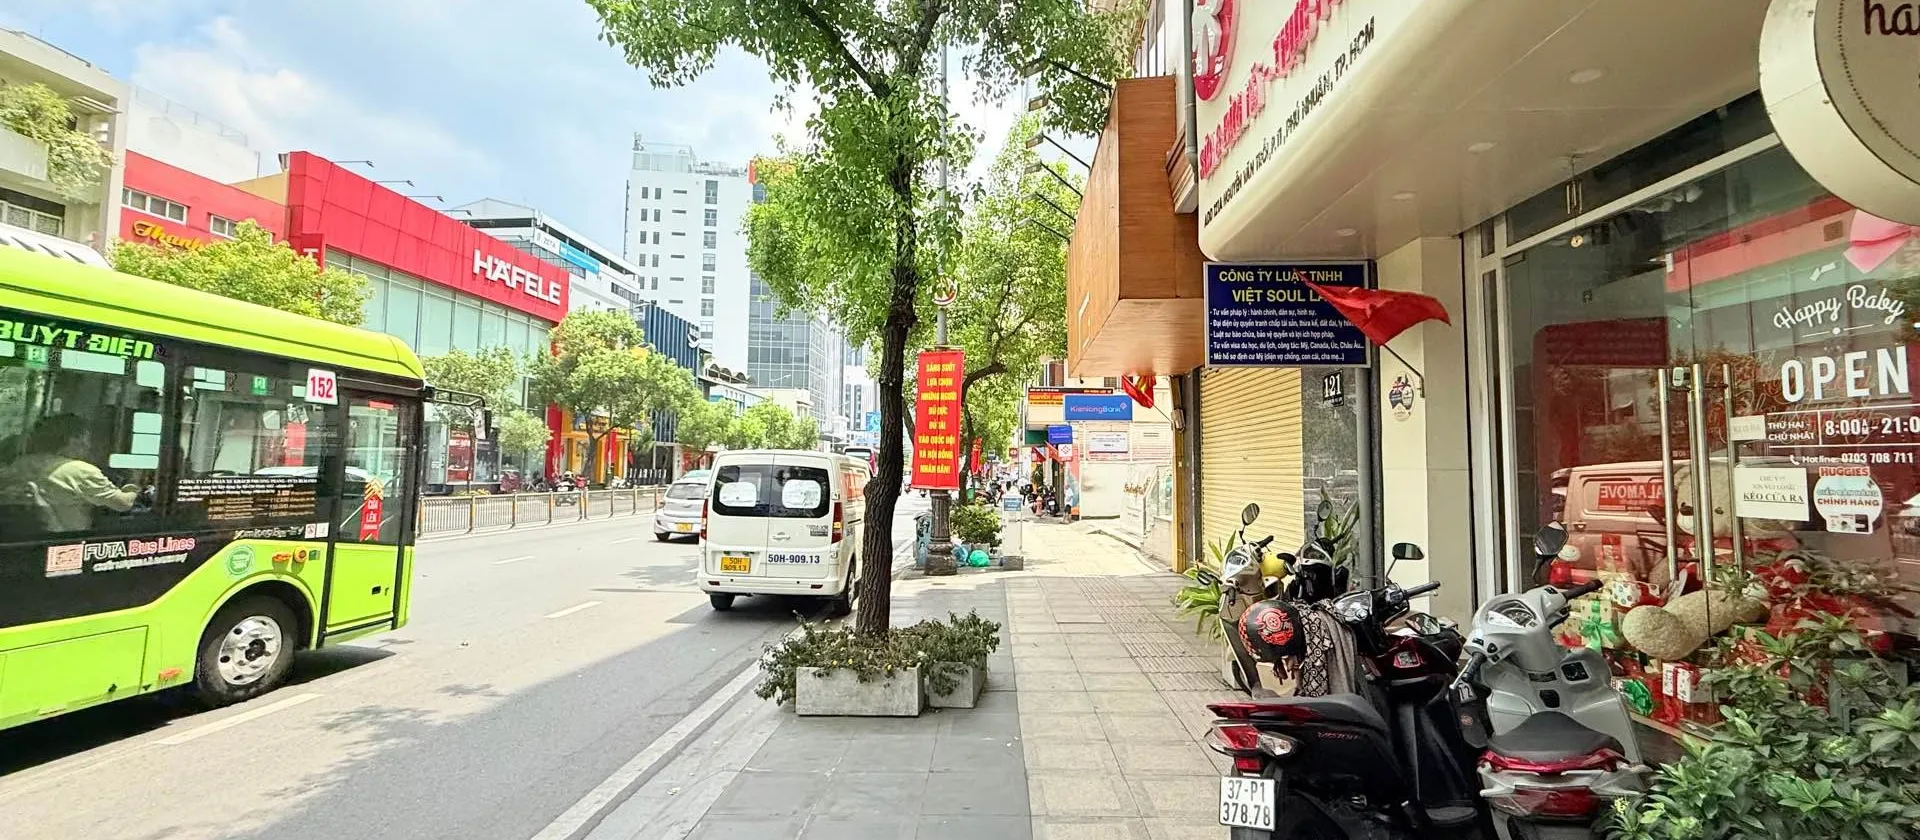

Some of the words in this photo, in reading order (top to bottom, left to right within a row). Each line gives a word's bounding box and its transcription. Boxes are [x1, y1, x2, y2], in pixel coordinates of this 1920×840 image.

[1864, 0, 1920, 35] ha
[1350, 16, 1375, 65] HCM
[473, 249, 561, 306] HÄFELE
[1219, 268, 1255, 282] CÔNG
[1257, 270, 1273, 282] TY
[1309, 270, 1343, 282] TNHH
[1232, 286, 1263, 306] VIỆT
[1266, 289, 1306, 303] SOUL
[1773, 296, 1842, 329] Happy
[1846, 284, 1905, 325] Baby
[1781, 345, 1910, 403] OPEN
[310, 376, 333, 399] 152
[1324, 374, 1342, 398] 121
[1767, 419, 1787, 431] THỨ
[1789, 422, 1805, 430] HAI
[1768, 430, 1788, 441] CHỦ
[1841, 453, 1867, 464] 0703
[1870, 453, 1891, 464] 708
[1893, 452, 1914, 464] 711
[1820, 467, 1870, 477] HUGGIES
[1743, 490, 1764, 501] KÉO
[1789, 493, 1805, 503] RA
[84, 541, 127, 560] FUTA
[128, 540, 157, 556] Bus
[158, 537, 195, 553] Lines
[768, 554, 820, 564] 50H-909.13
[723, 563, 747, 572] 909.13
[1227, 778, 1266, 800] 37-P1
[1222, 801, 1271, 828] 378.78
